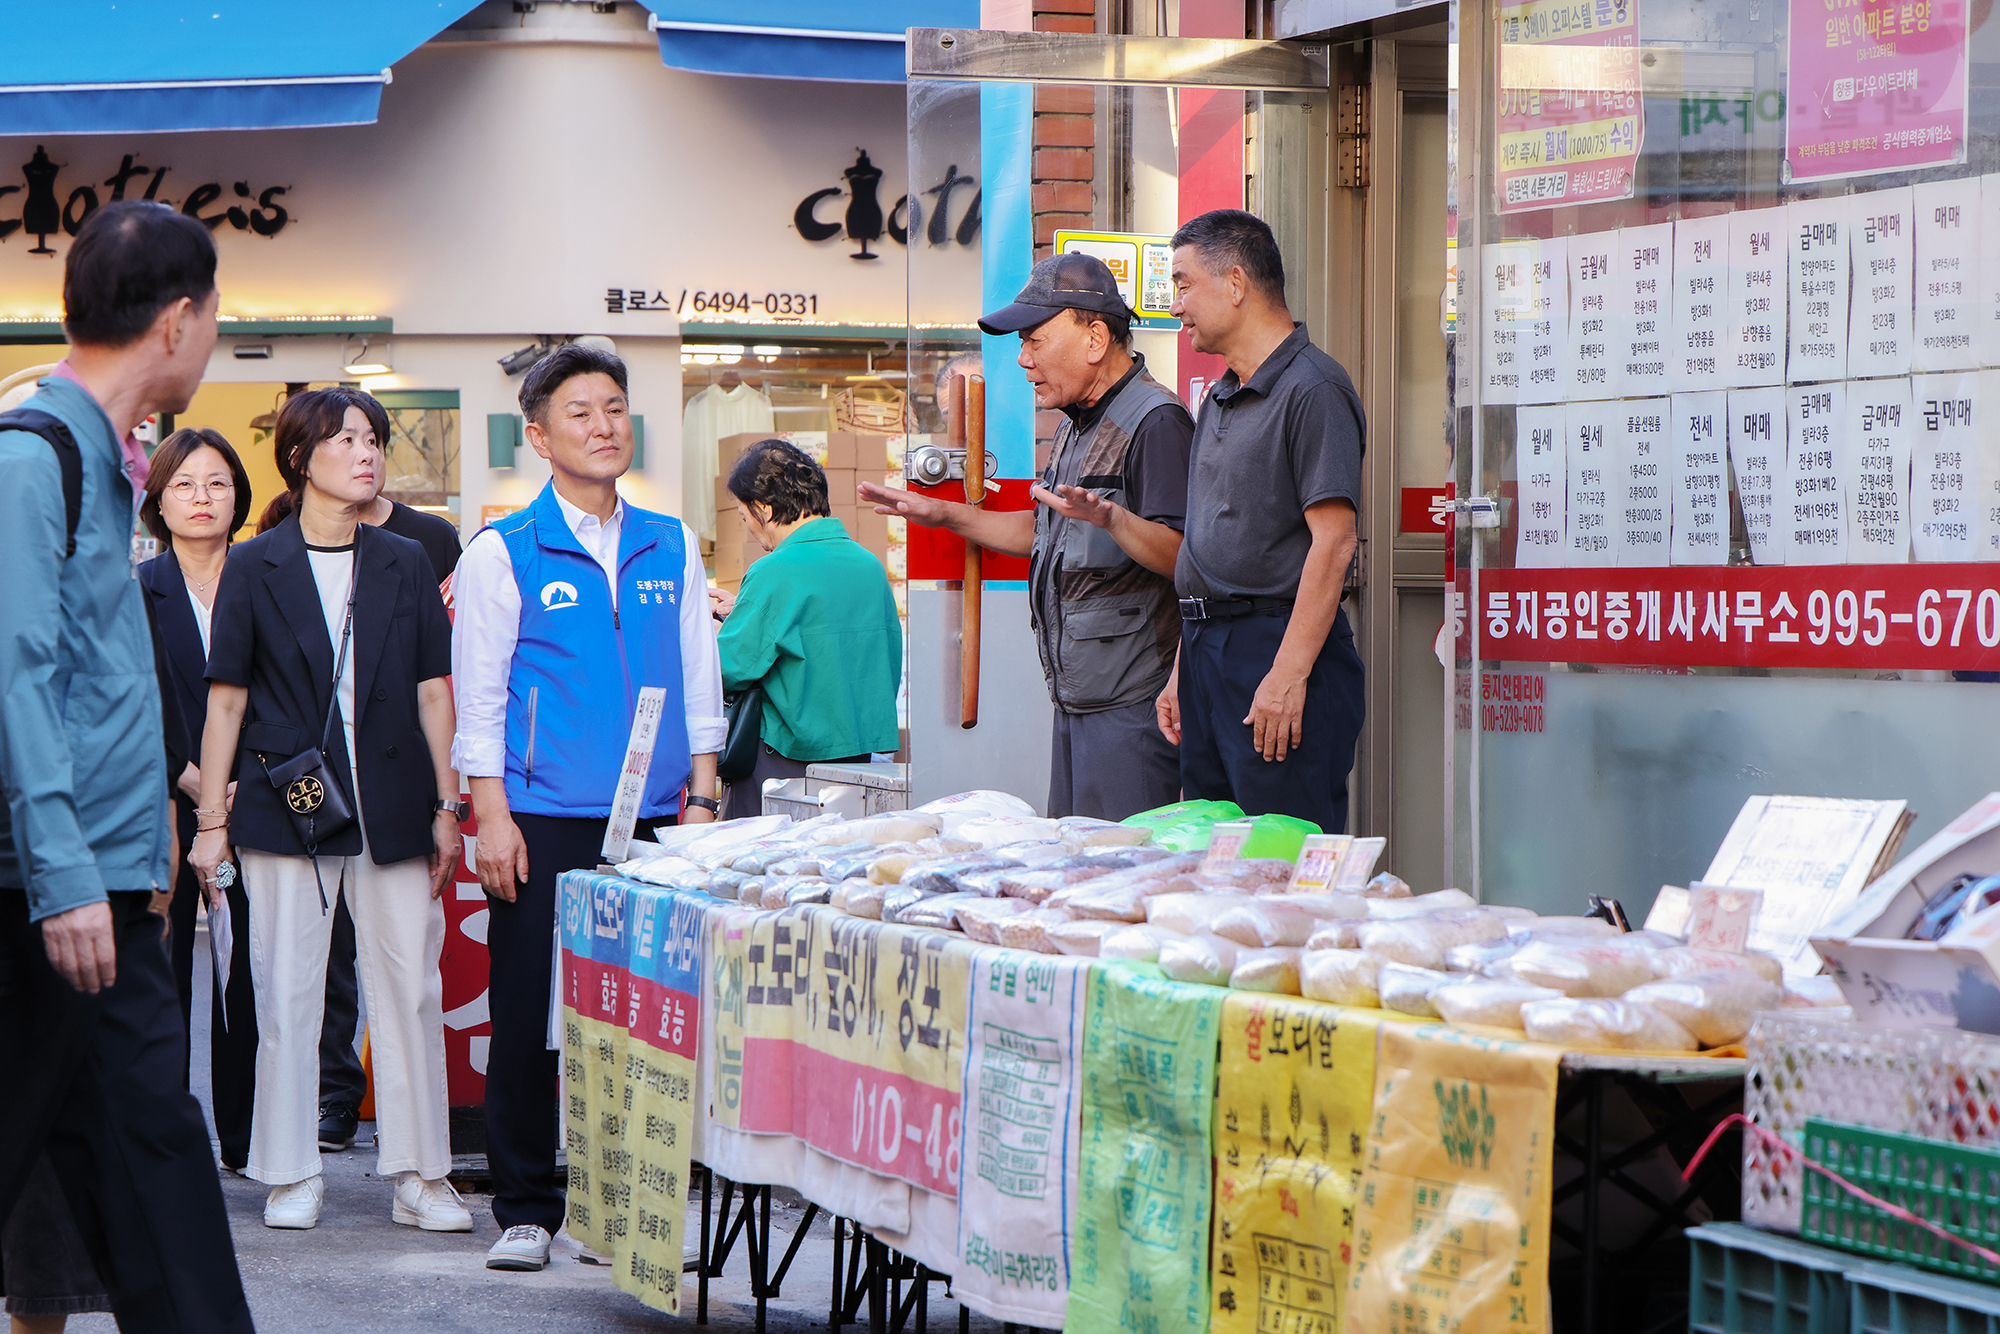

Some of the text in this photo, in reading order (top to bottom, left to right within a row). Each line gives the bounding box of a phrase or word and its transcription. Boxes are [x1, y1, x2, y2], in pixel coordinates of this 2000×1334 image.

[1552, 2, 1592, 33] 오피스텔
[1595, 0, 1627, 27] 분양
[1899, 2, 1932, 35] 분양
[1520, 141, 1541, 164] 즉시
[1545, 130, 1567, 161] 월세
[1610, 119, 1634, 154] 수익
[1798, 144, 1816, 158] 계약자
[1818, 140, 1835, 156] 부담을
[1852, 137, 1878, 152] 파격조건
[1883, 124, 1952, 151] 공식협력중개업소
[1531, 175, 1565, 198] 4분거리
[1934, 206, 1960, 228] 매매
[1800, 223, 1836, 250] 급매매
[1863, 214, 1900, 243] 급매매
[1693, 240, 1711, 263] 전세
[1749, 232, 1769, 255] 월세
[1633, 247, 1659, 269] 급매매
[1533, 260, 1551, 283] 전세
[1580, 255, 1607, 280] 급월세
[1869, 258, 1896, 275] 빌라4층
[1494, 264, 1515, 291] 월세
[1689, 277, 1714, 294] 빌라4층
[1745, 270, 1771, 287] 빌라4층
[1635, 279, 1656, 293] 빌라4층
[1871, 285, 1895, 303] 방3화2
[1927, 282, 1961, 296] 전용15.5평
[605, 289, 669, 313] 클로스
[693, 291, 818, 314] 6494-0331
[1534, 297, 1551, 309] 다가구
[1582, 295, 1603, 310] 빌라4층
[1633, 300, 1657, 314] 전용18평
[1745, 298, 1770, 315] 방3화2
[1806, 302, 1829, 317] 22평형
[1690, 304, 1711, 321] 방3화1
[1933, 309, 1955, 323] 방3화2
[1533, 321, 1550, 336] 반지층
[1581, 320, 1603, 335] 방3화2
[1636, 321, 1655, 335] 방3화2
[1871, 313, 1895, 330] 전23평
[1742, 325, 1771, 342] 남향좋음
[1807, 323, 1828, 337] 세안고
[1687, 331, 1714, 347] 남향좋음
[1923, 335, 1969, 349] 매가2억8천5백
[1533, 345, 1551, 360] 방2화1
[1800, 343, 1835, 358] 매가5억5천
[1869, 341, 1896, 356] 매가3억
[1626, 362, 1664, 375] 매매31500만
[1685, 357, 1714, 374] 전1억6천
[1737, 353, 1775, 369] 보3천월80
[1530, 368, 1555, 383] 4천5백만
[1576, 368, 1606, 383] 5천/80만
[1800, 393, 1831, 418] 급매매
[1861, 404, 1900, 431] 급매매
[1923, 399, 1971, 430] 급매매
[1626, 416, 1661, 432] 풀옵션원룸
[1689, 415, 1712, 441] 전세
[1743, 412, 1770, 441] 매매
[1531, 429, 1551, 455] 월세
[1579, 425, 1602, 451] 월세
[1802, 425, 1829, 444] 빌라3층
[1637, 442, 1649, 456] 전세
[1868, 438, 1889, 451] 다가구
[1685, 453, 1718, 467] 한양아파트
[1746, 457, 1767, 470] 빌라3층
[1798, 451, 1831, 470] 전용16평
[1861, 456, 1892, 475] 대지31평
[1934, 452, 1961, 469] 빌라3층
[1581, 470, 1600, 485] 빌라식
[1629, 464, 1656, 479] 1층4500
[1531, 474, 1551, 488] 다가구
[1684, 474, 1719, 489] 남향30평형
[1740, 475, 1771, 490] 전용17.3평
[1795, 477, 1836, 497] 방3화1베2
[1860, 474, 1895, 493] 건평48평
[1930, 473, 1962, 490] 전용18평
[1576, 492, 1605, 507] 다가구2층
[1628, 487, 1657, 501] 2층5000
[1690, 494, 1716, 508] 올수리함
[1857, 492, 1897, 508] 보2천월90
[1531, 502, 1551, 518] 1층방1
[1793, 502, 1838, 521] 전세1억6천
[1932, 499, 1959, 515] 방3화2
[1578, 514, 1603, 529] 큰방2화1
[1625, 509, 1662, 523] 반층300/25
[1693, 513, 1713, 527] 방3화1
[1856, 510, 1899, 526] 2층주인거주
[1524, 530, 1558, 545] 보1천/월30
[1626, 531, 1661, 545] 3층500/40
[1687, 533, 1718, 546] 전세4억1천
[1794, 529, 1837, 545] 매매1억9천
[1862, 529, 1894, 545] 매5억2천
[1922, 523, 1966, 540] 매가2억5천
[1574, 536, 1607, 551] 보1천/월50
[637, 580, 674, 590] 도봉구청장
[1482, 674, 1543, 704] 둥지인테리어
[1482, 705, 1543, 732] 010-5239-9078
[602, 972, 685, 1045] 효능 능 효능
